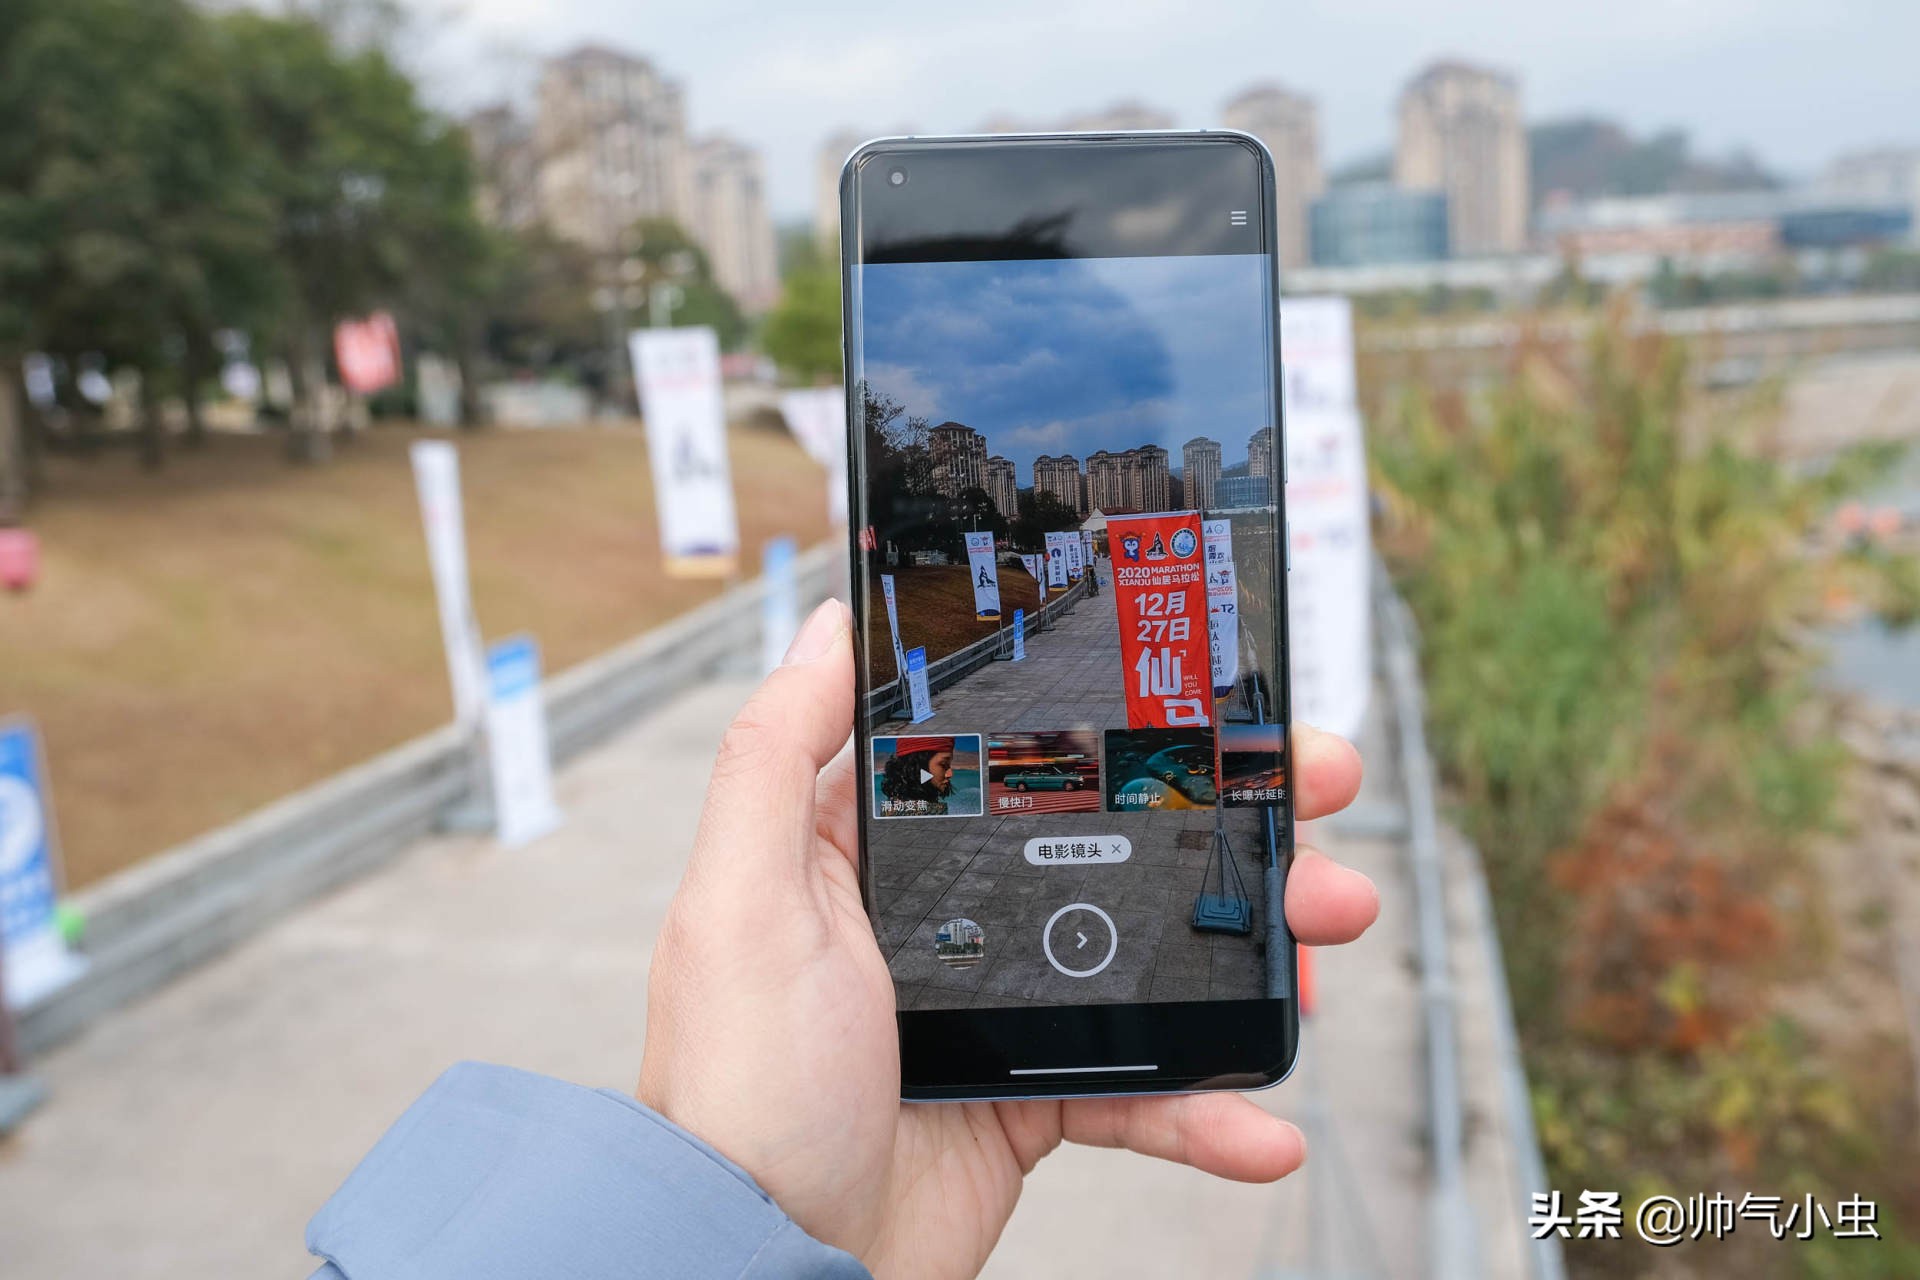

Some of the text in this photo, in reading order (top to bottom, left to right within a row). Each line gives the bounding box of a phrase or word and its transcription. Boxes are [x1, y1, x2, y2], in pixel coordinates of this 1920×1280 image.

[1117, 563, 1199, 578] 2020 MARATHON
[1152, 571, 1200, 585] 仙居马拉松
[1135, 591, 1186, 616] 12月
[1136, 617, 1190, 643] 27日
[1135, 647, 1182, 697] 仙
[998, 796, 1033, 808] 慢快门
[1115, 792, 1161, 804] 时间静止
[1232, 789, 1286, 801] 长曝光延时
[881, 800, 929, 811] 滑动变焦
[1038, 843, 1102, 859] 电影镜头
